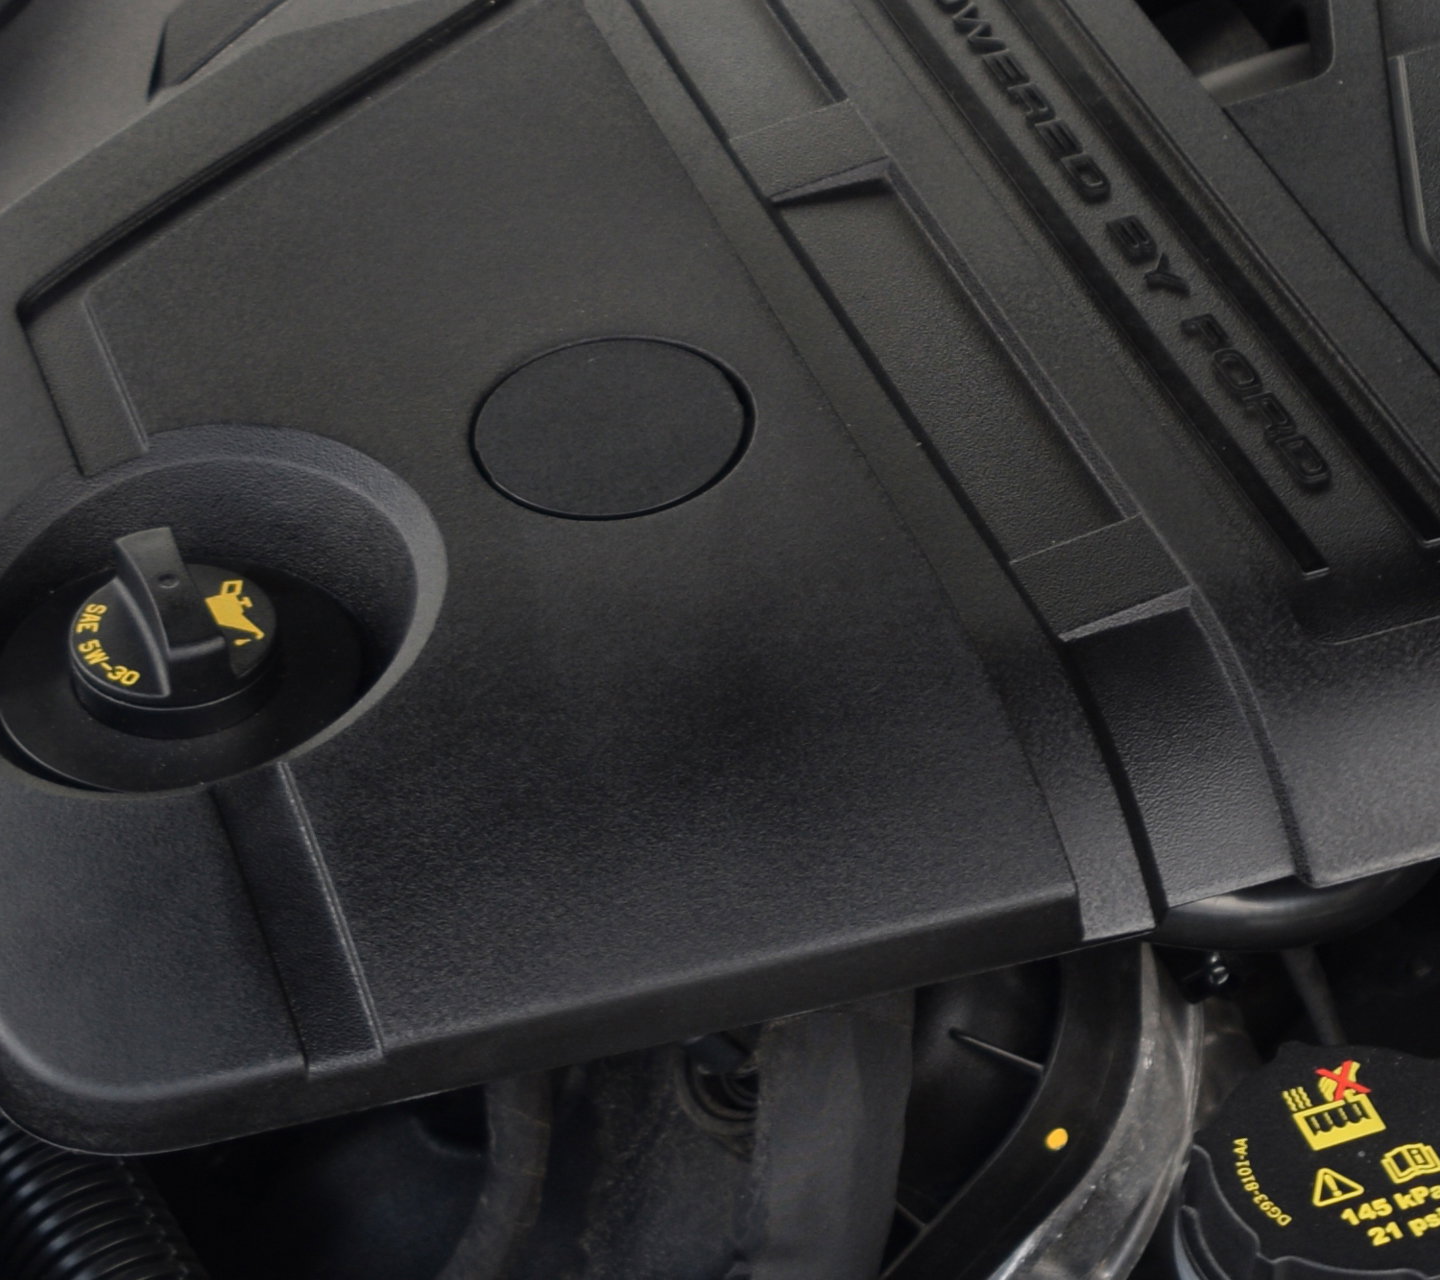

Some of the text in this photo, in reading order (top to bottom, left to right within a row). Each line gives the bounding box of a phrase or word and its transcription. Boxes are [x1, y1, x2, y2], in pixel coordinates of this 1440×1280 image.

[1104, 213, 1192, 302] BY
[1180, 311, 1333, 492] FORD
[75, 602, 141, 688] SAE 5W-30
[1339, 1197, 1394, 1227] 145
[1366, 1220, 1404, 1247] 21
